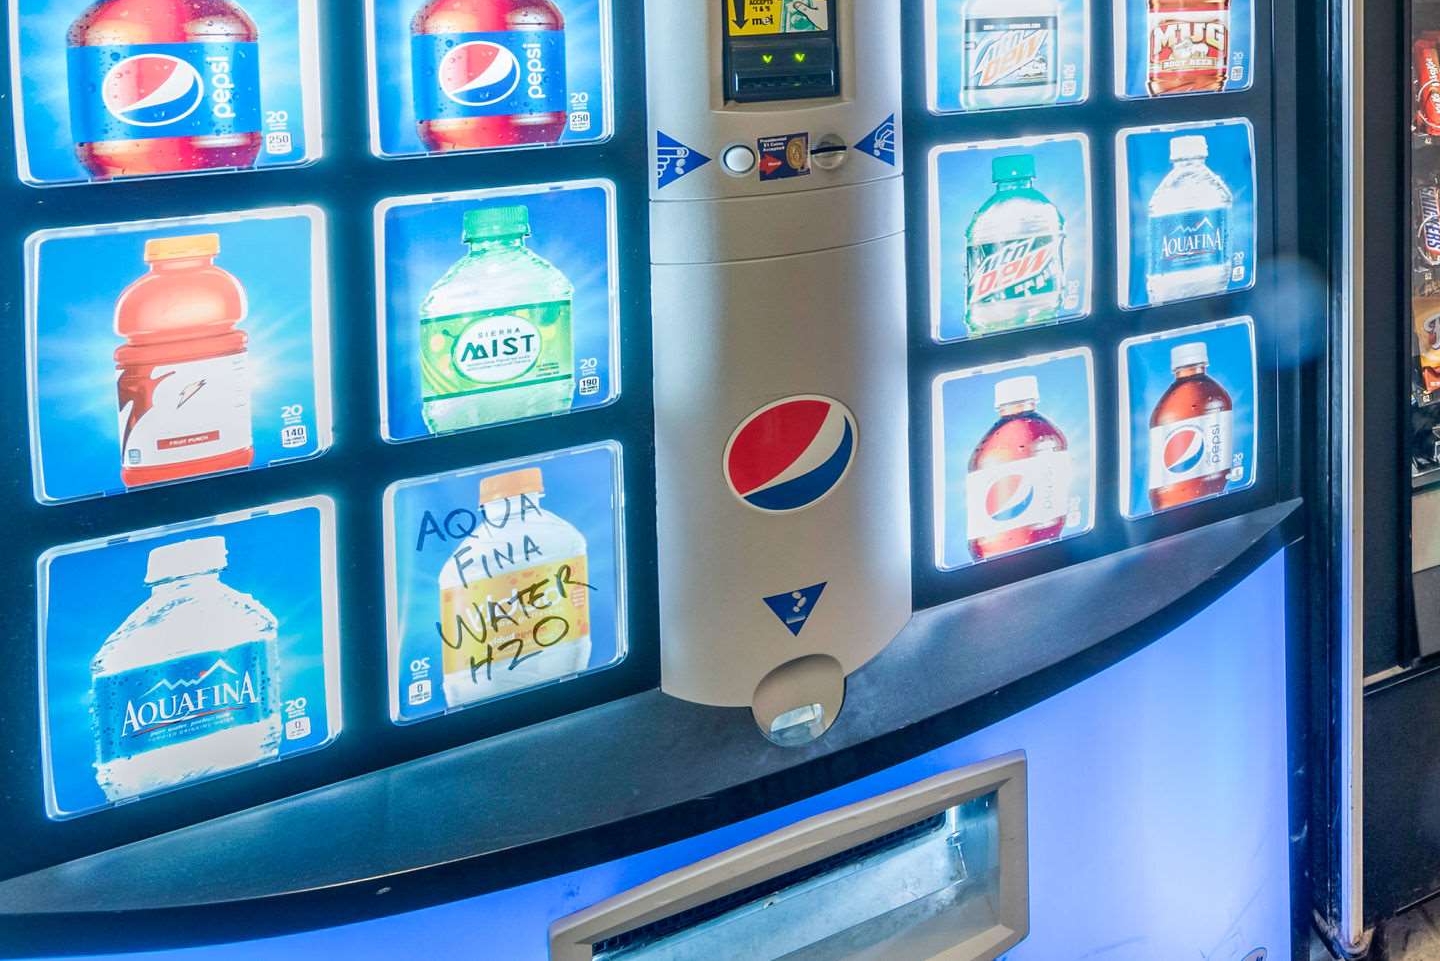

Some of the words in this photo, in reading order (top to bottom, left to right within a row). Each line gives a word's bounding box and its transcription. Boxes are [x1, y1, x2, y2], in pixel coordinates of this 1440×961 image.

[1152, 22, 1226, 56] MUG
[529, 42, 547, 99] pepsi
[206, 56, 236, 119] pepsi
[571, 93, 588, 103] 20
[266, 111, 288, 122] 20
[571, 114, 588, 123] 250
[1162, 228, 1222, 257] AQUAFINA
[478, 327, 521, 339] SIERRA
[461, 334, 535, 362] MIST
[580, 358, 597, 370] 20
[282, 405, 303, 418] 20
[286, 428, 304, 438] 140
[1210, 424, 1221, 464] pepsi
[415, 493, 543, 551] AQUA
[453, 535, 544, 589] FINA
[436, 564, 598, 650] WATER
[470, 616, 570, 684] H2O
[121, 670, 259, 737] AQUAFINA
[285, 697, 307, 712] 20
